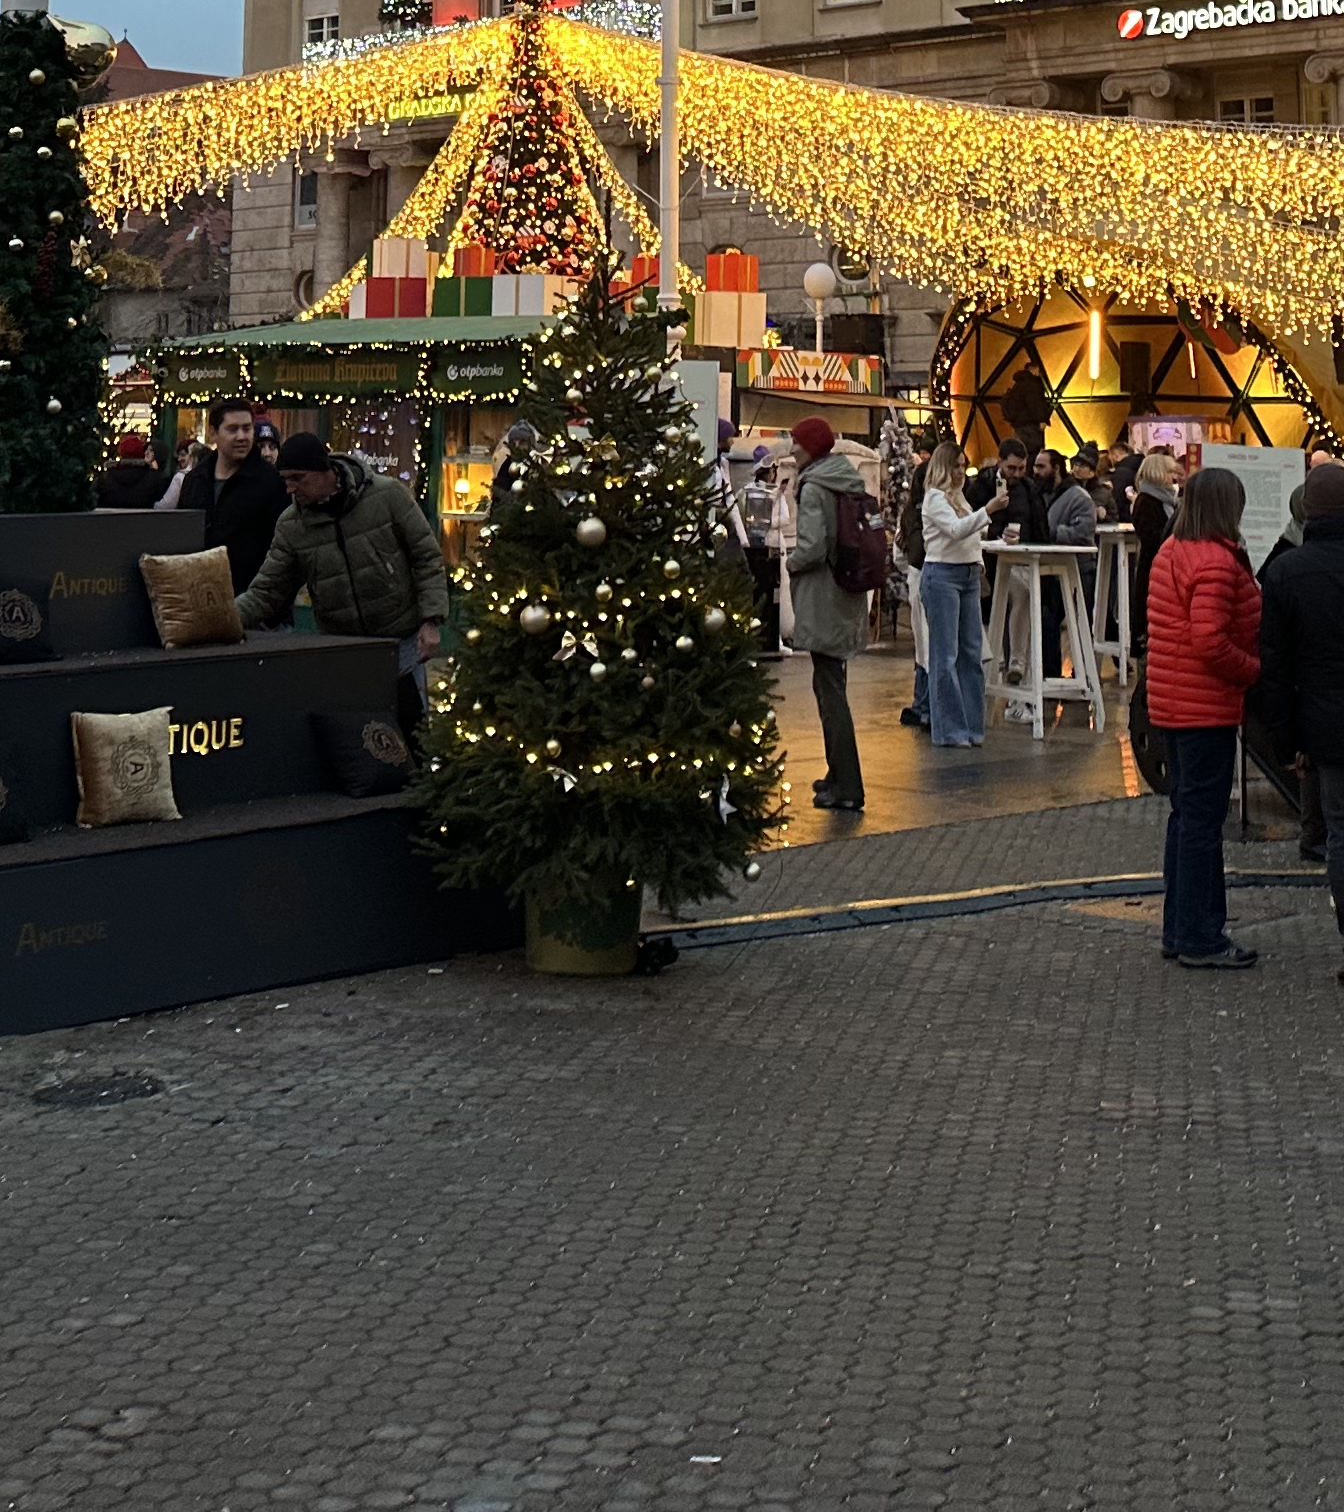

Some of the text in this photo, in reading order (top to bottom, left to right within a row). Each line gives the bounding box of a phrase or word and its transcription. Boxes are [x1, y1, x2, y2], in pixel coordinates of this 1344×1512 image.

[459, 363, 504, 381] otpbanka
[363, 452, 399, 467] pbanka
[167, 717, 245, 757] TIQUE
